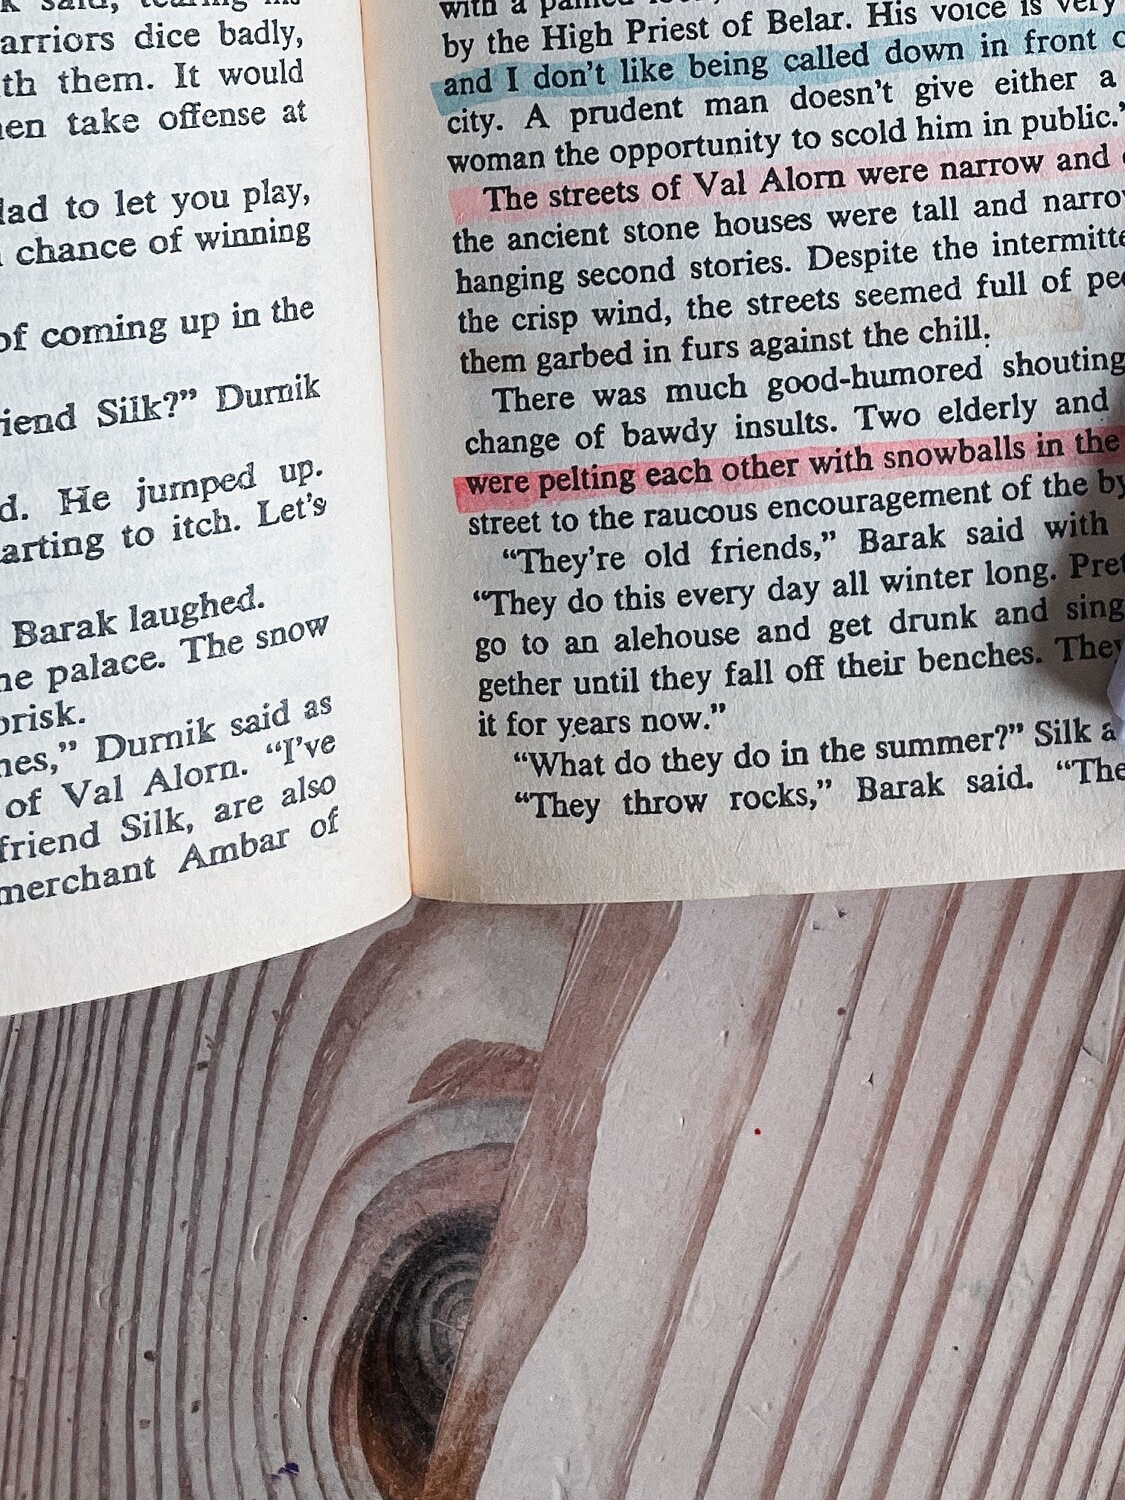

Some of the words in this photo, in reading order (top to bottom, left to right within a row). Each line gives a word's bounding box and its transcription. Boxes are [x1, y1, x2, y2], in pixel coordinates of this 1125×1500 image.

[134, 21, 201, 50] dice
[217, 18, 303, 52] badly,
[443, 67, 494, 97] and
[505, 65, 520, 93] I
[533, 60, 607, 91] don’t
[619, 56, 675, 84] like
[687, 50, 769, 81] being
[783, 40, 871, 73] called
[884, 37, 965, 65] down
[980, 31, 1009, 59] in
[1023, 28, 1098, 55] front
[446, 150, 546, 174] woman
[554, 140, 600, 168] the
[609, 127, 782, 170] opportunity
[791, 128, 822, 151] to
[830, 116, 908, 148] scold
[915, 114, 974, 142] him
[982, 110, 1013, 137] in
[64, 195, 100, 220] to
[114, 189, 158, 217] let
[170, 189, 230, 219] you
[242, 177, 310, 214] play,
[454, 264, 565, 298] hanging
[576, 254, 677, 289] second
[690, 248, 792, 280] stories.
[806, 238, 919, 274] Despite
[931, 234, 978, 262] the
[40, 313, 168, 349] coming
[179, 311, 220, 340] up
[232, 301, 262, 330] in
[270, 295, 315, 324] the
[459, 347, 528, 375] them
[536, 338, 634, 378] garbed
[642, 337, 672, 365] in
[680, 334, 740, 362] furs
[749, 326, 854, 362] against
[862, 320, 910, 348] the
[918, 313, 991, 346] chill.
[502, 545, 626, 580] “They’re
[644, 540, 691, 569] old
[710, 529, 836, 566] friends,”
[857, 522, 947, 555] Barak
[966, 515, 1025, 546] said
[1043, 509, 1110, 540] with
[11, 608, 118, 649] Barak
[128, 583, 265, 633] laughed.
[475, 636, 507, 663] go
[521, 632, 550, 656] to
[564, 635, 600, 655] an
[614, 622, 741, 653] alehouse
[756, 614, 812, 645] and
[828, 613, 873, 645] get
[888, 602, 979, 635] drunk
[994, 595, 1050, 627] and
[1066, 593, 1125, 623] sing
[478, 709, 498, 738] it
[506, 710, 548, 738] for
[555, 715, 631, 743] years
[640, 702, 727, 733] now.”
[5, 786, 42, 819] of
[60, 773, 124, 809] Val
[142, 759, 248, 797] Alorn.
[266, 734, 336, 766] “I’ve
[514, 791, 601, 825] “They
[622, 788, 708, 816] throw
[729, 778, 833, 811] rocks,”
[855, 770, 946, 803] Barak
[966, 763, 1034, 794] said.
[0, 855, 157, 907] merchant
[178, 828, 290, 874] Ambar
[310, 805, 339, 839] of
